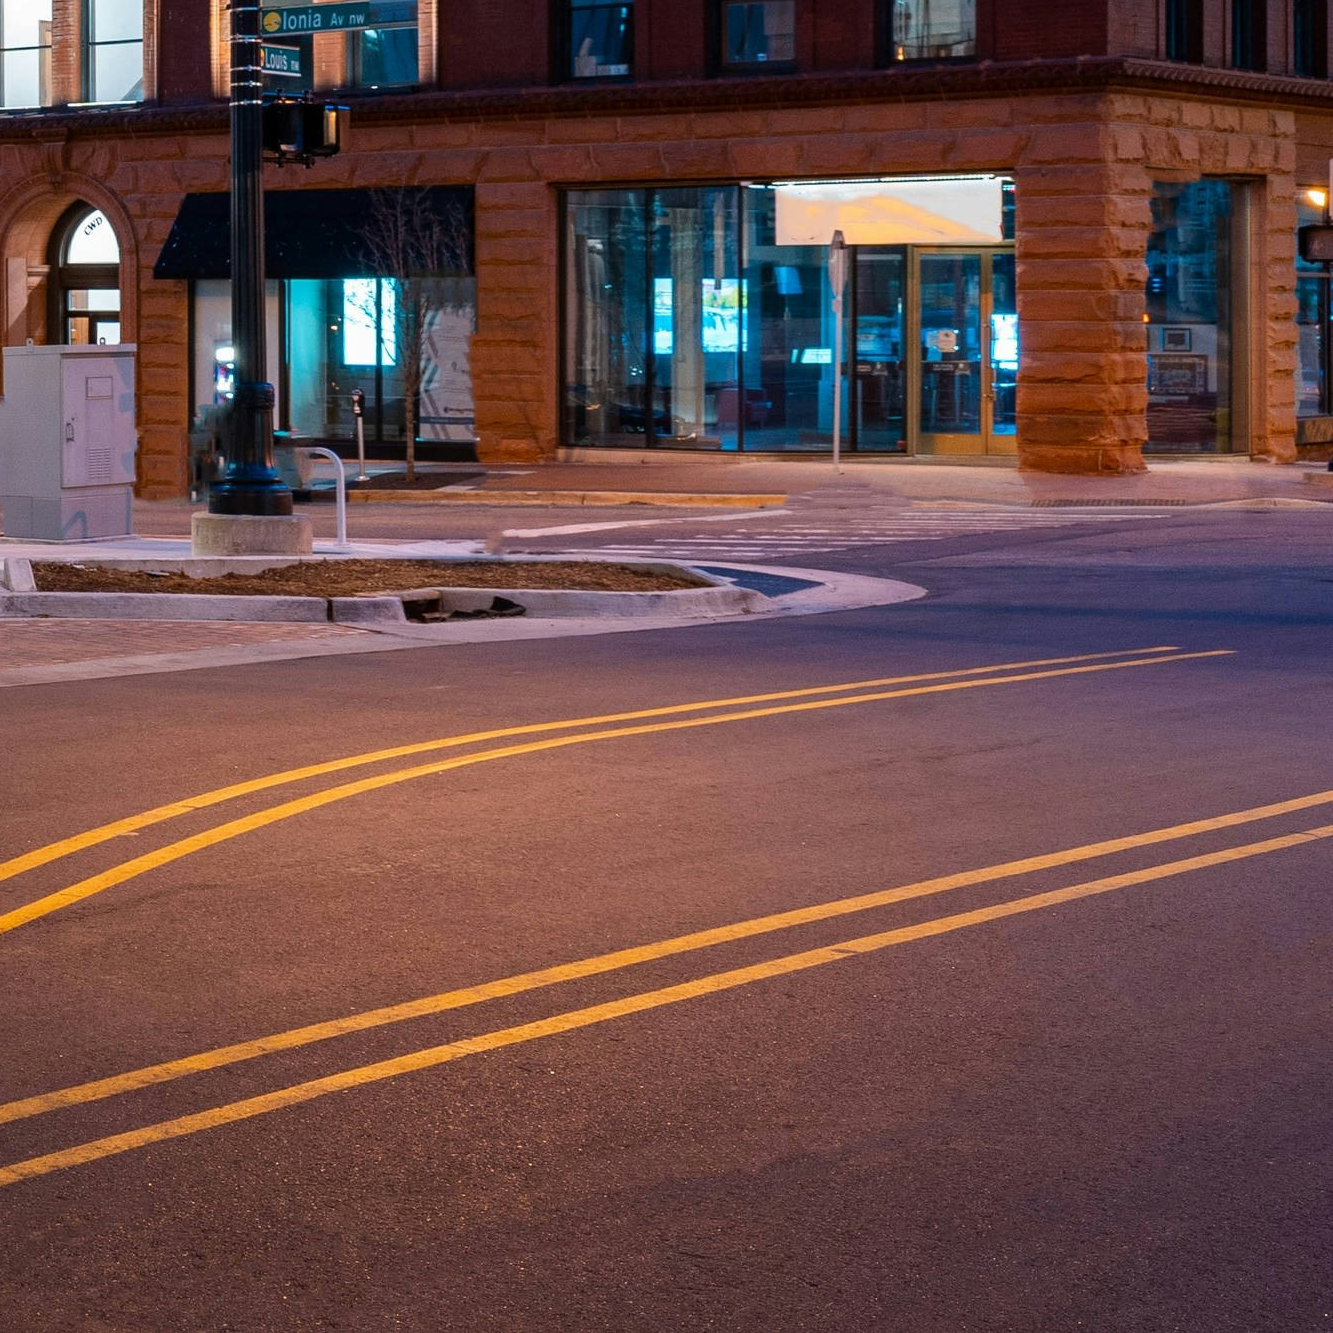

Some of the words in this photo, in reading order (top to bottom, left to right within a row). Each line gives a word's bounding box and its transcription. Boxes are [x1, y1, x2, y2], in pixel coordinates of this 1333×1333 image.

[283, 9, 322, 30] Ionia
[330, 12, 345, 27] Av
[265, 48, 288, 71] Louis
[84, 216, 103, 236] CWD
